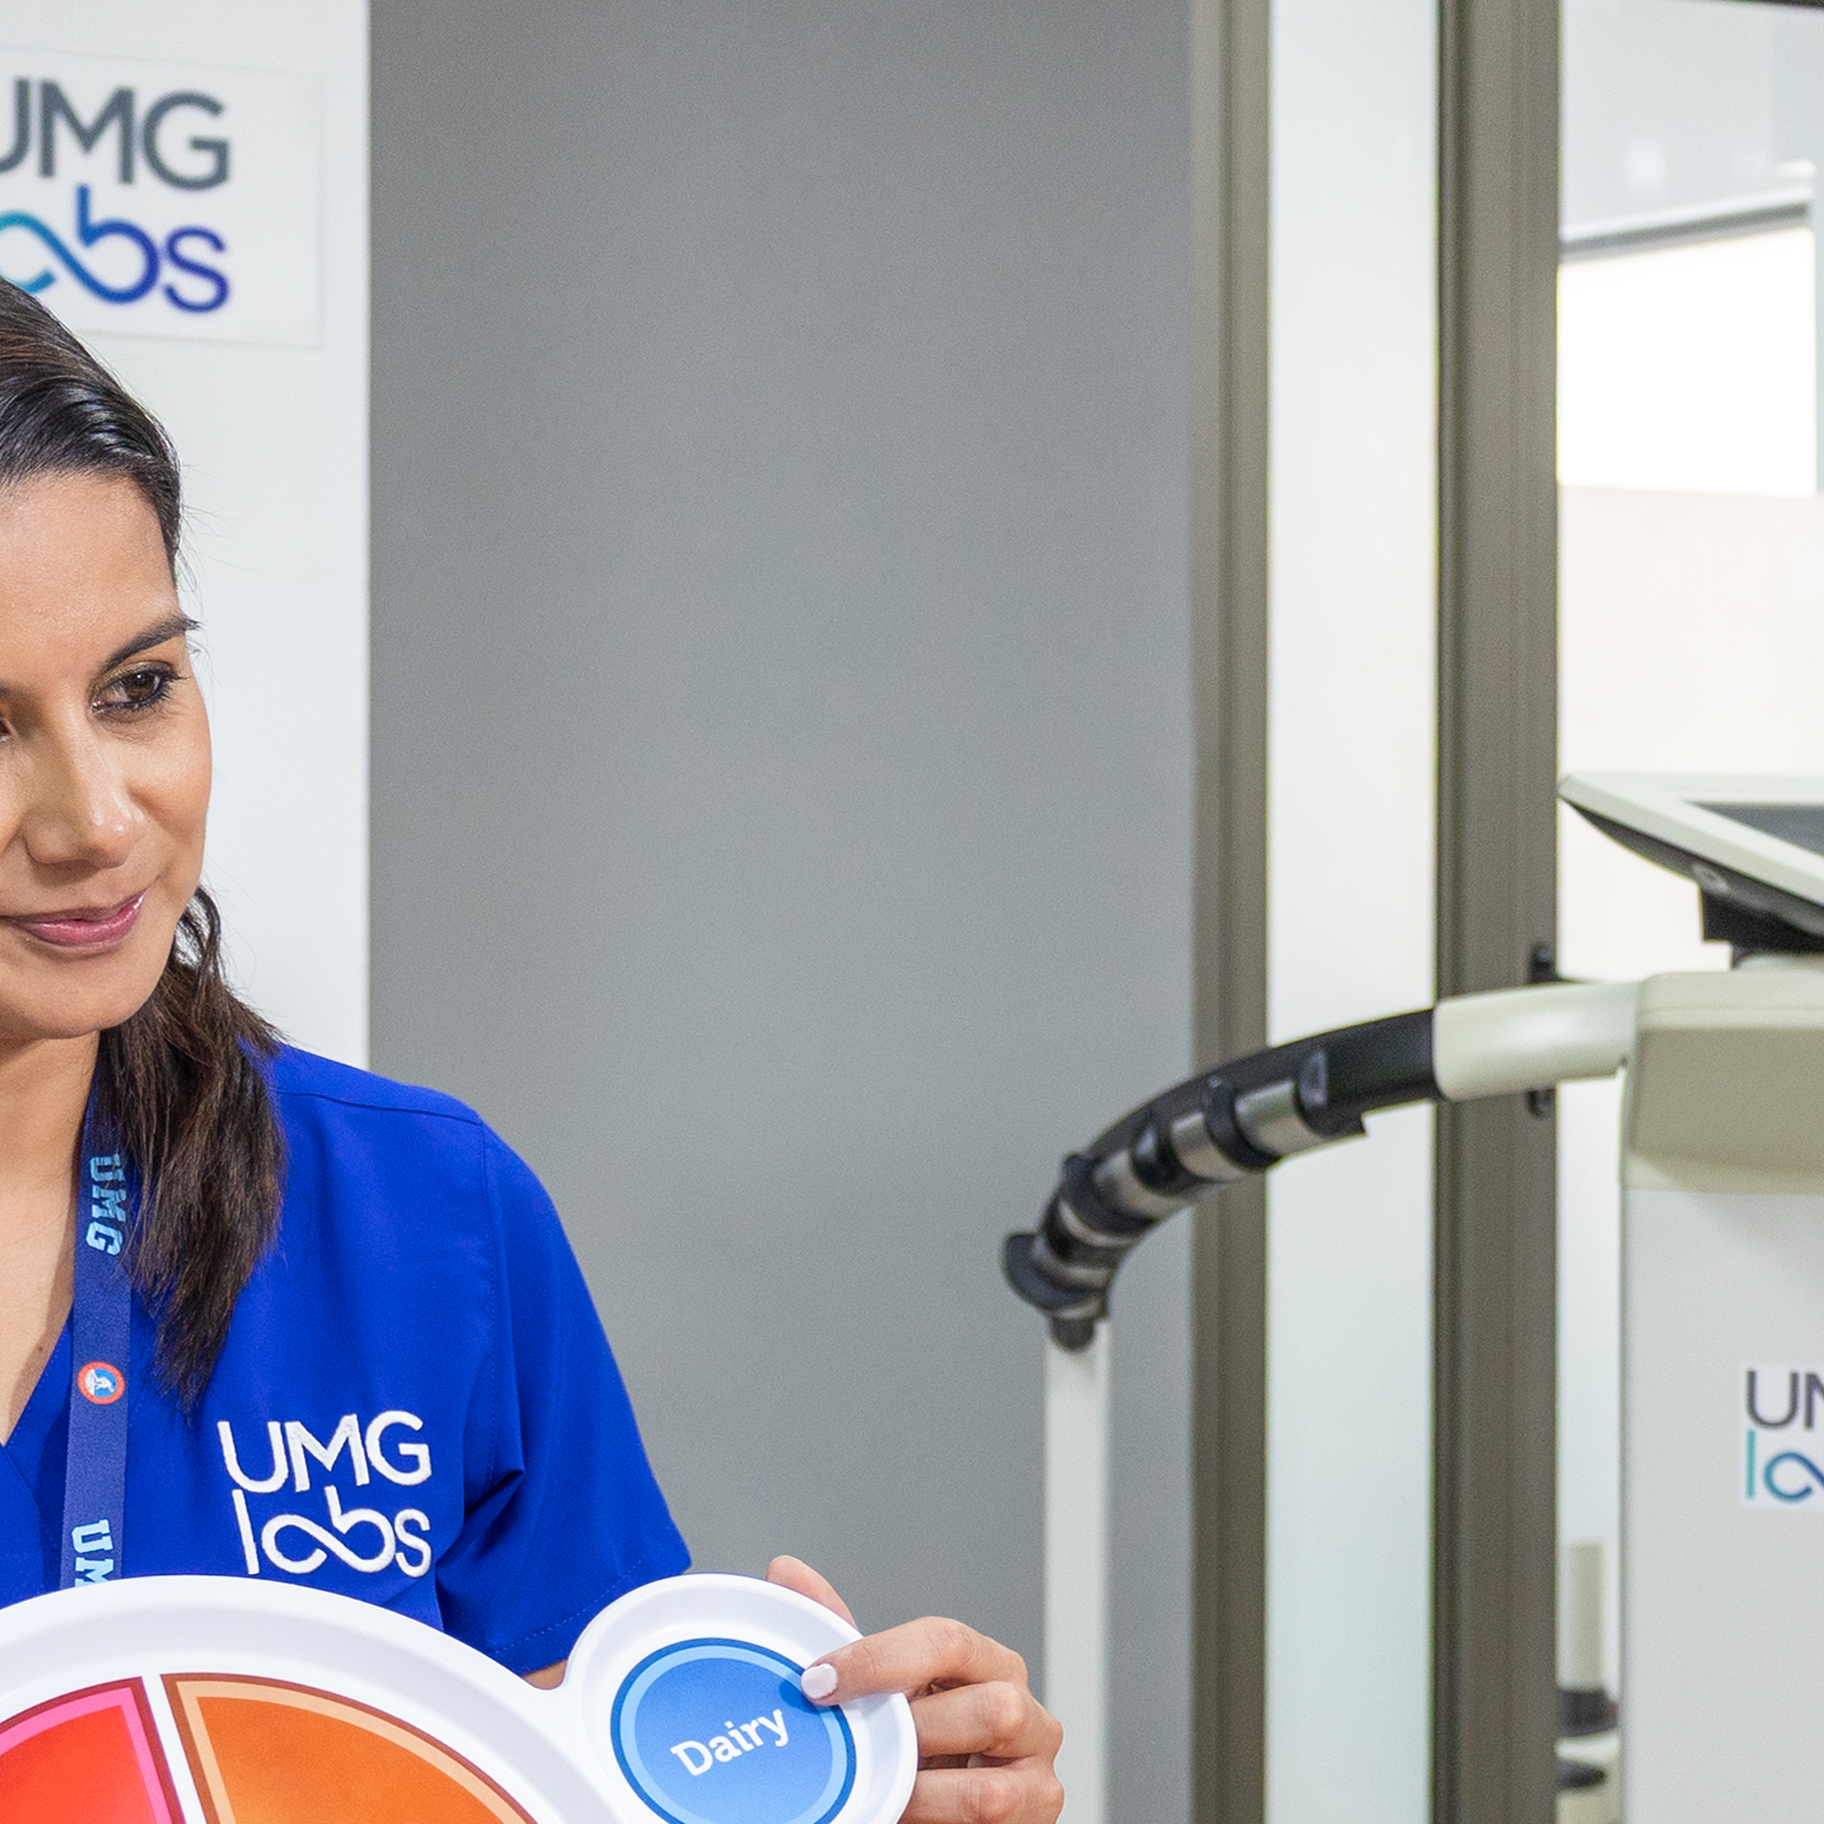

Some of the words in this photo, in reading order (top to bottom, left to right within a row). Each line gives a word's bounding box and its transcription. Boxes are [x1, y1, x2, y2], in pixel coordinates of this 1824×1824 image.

[84, 1153, 126, 1257] UMG
[217, 1410, 432, 1493] UMG
[231, 1485, 432, 1578] labs
[669, 1707, 790, 1778] Dairy
